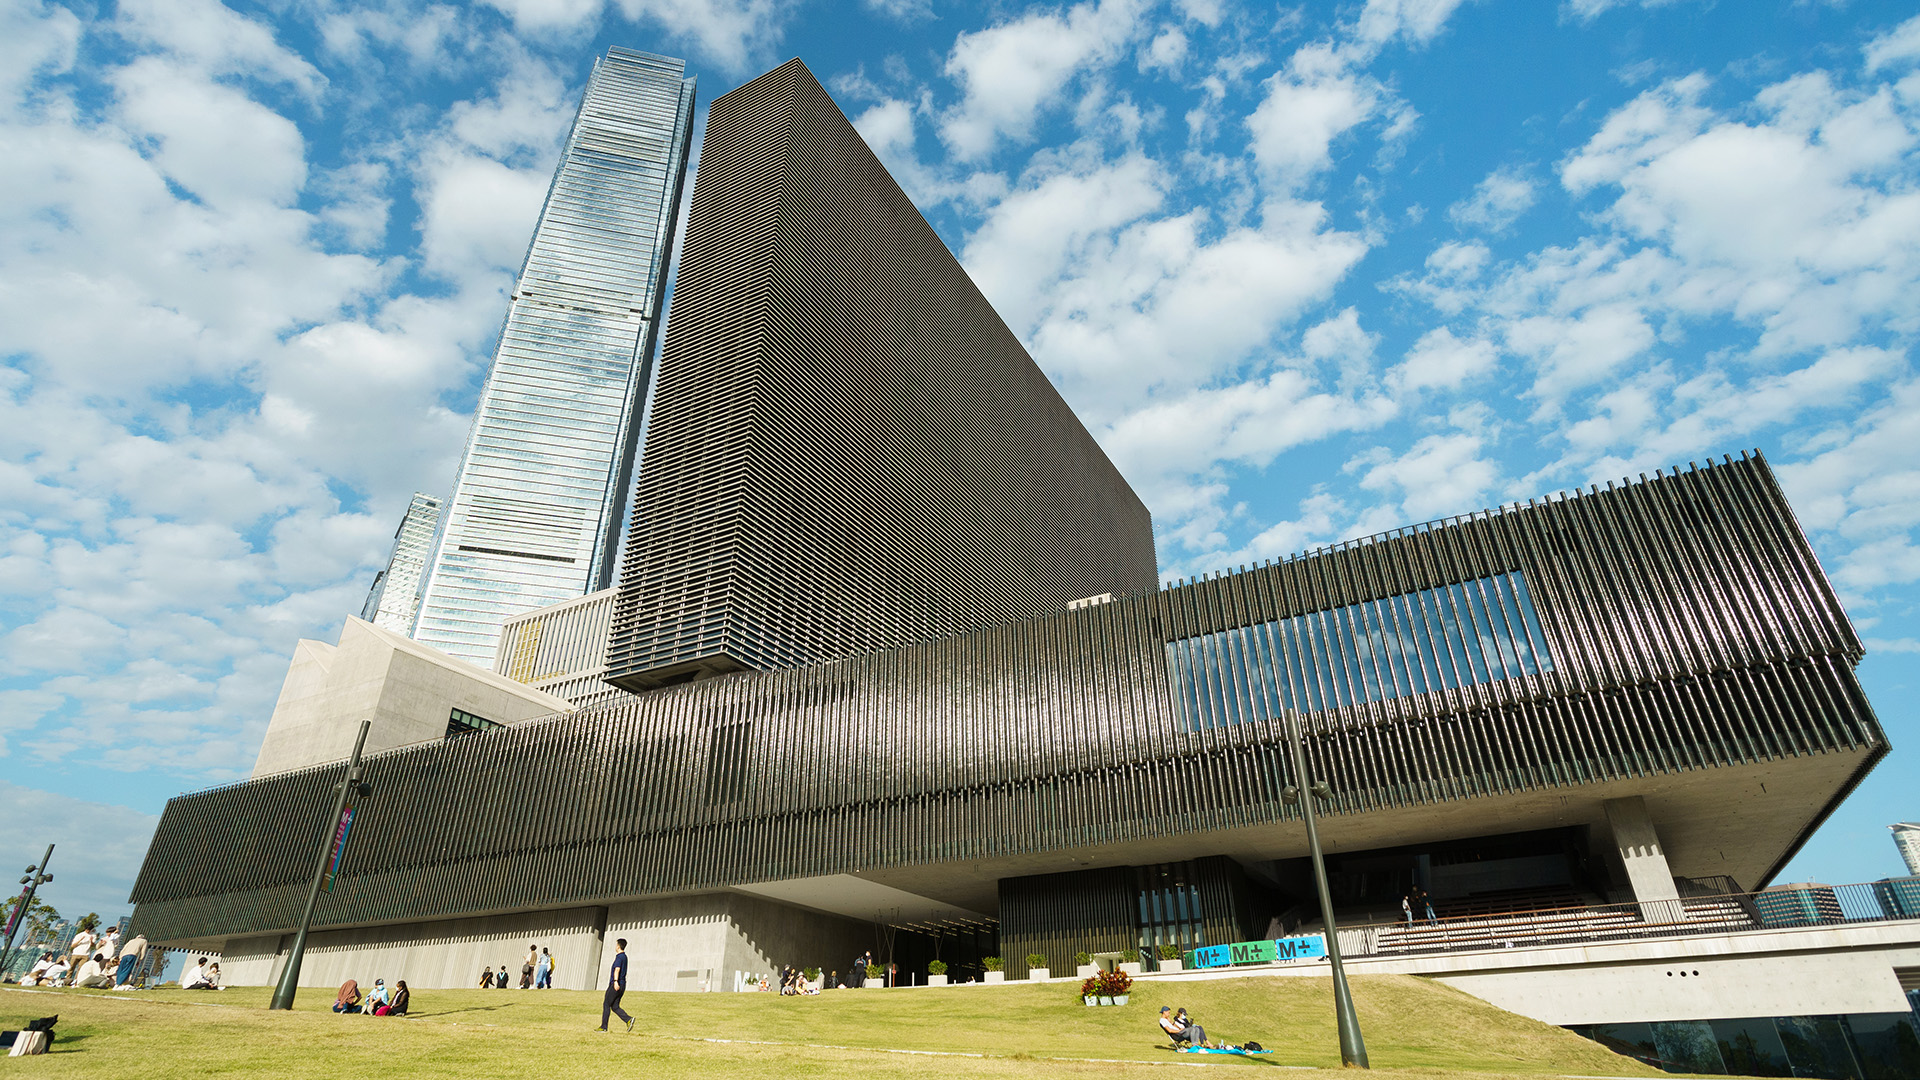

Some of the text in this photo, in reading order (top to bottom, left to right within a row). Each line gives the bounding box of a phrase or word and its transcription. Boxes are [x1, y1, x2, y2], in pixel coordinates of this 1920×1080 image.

[341, 811, 352, 824] M+
[1197, 949, 1220, 966] M+
[1232, 944, 1262, 962] M+
[1279, 941, 1310, 958] M+
